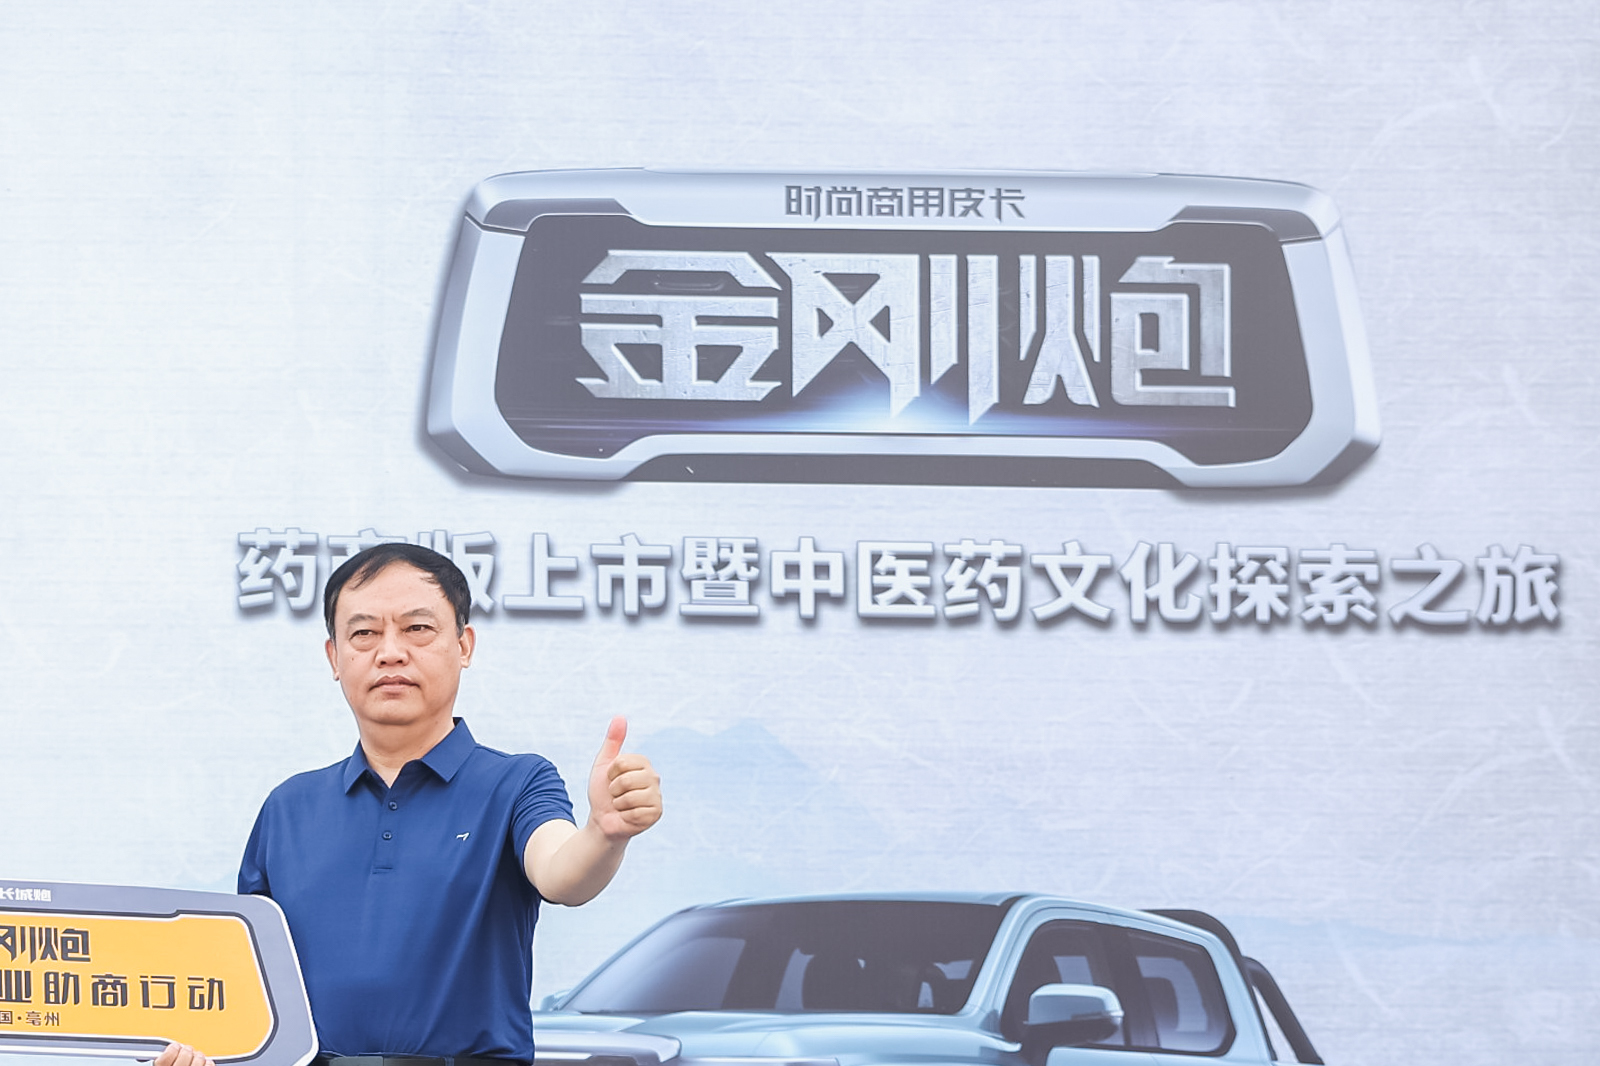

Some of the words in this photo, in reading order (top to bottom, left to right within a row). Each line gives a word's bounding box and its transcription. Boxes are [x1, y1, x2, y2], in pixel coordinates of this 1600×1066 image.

[785, 186, 1025, 223] 时尚商用皮卡
[576, 249, 1236, 426] 金刚炮
